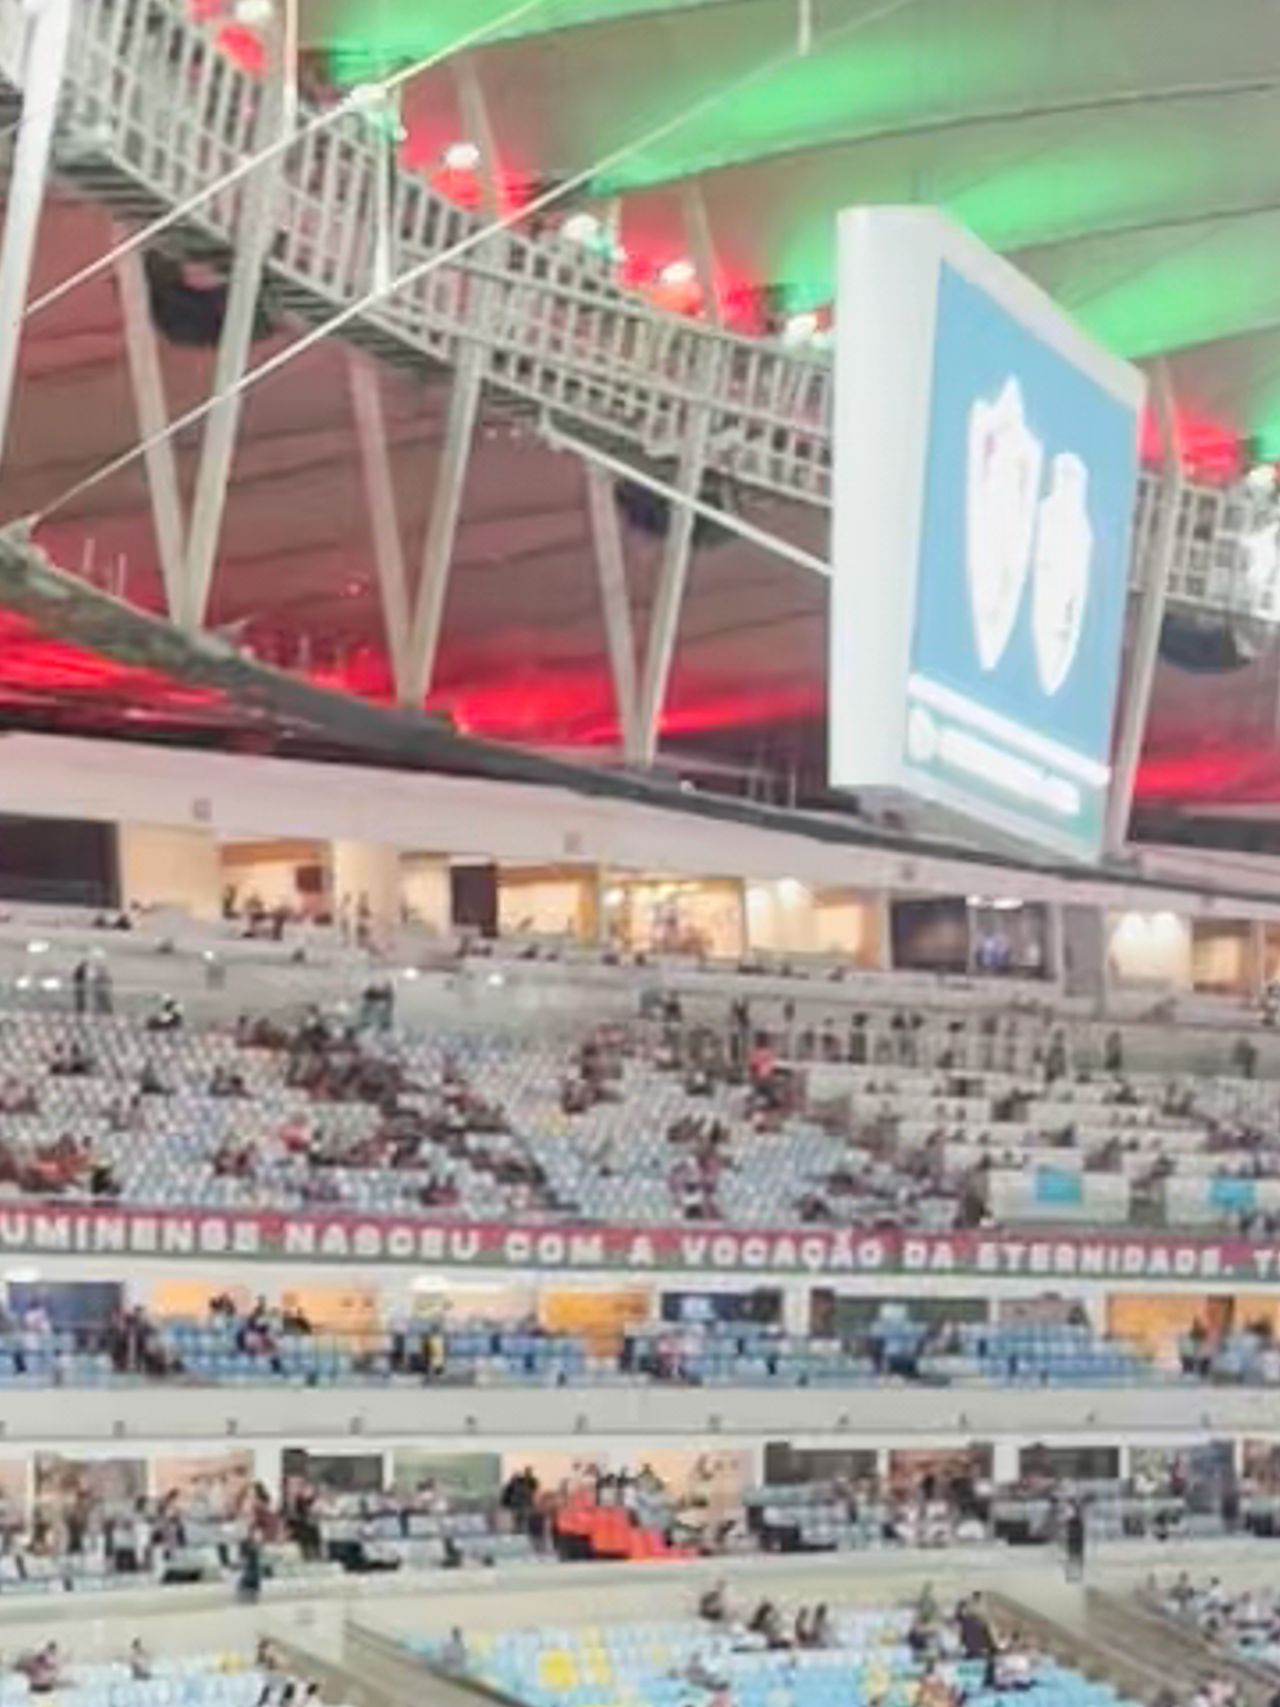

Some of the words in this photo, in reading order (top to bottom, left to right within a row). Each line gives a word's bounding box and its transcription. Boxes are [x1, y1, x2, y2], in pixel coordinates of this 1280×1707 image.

[284, 1221, 480, 1261] NASCEU
[504, 1231, 605, 1264] COM
[629, 1234, 654, 1265] A
[681, 1229, 884, 1270] VOCAÇÃO
[902, 1240, 954, 1270] DA
